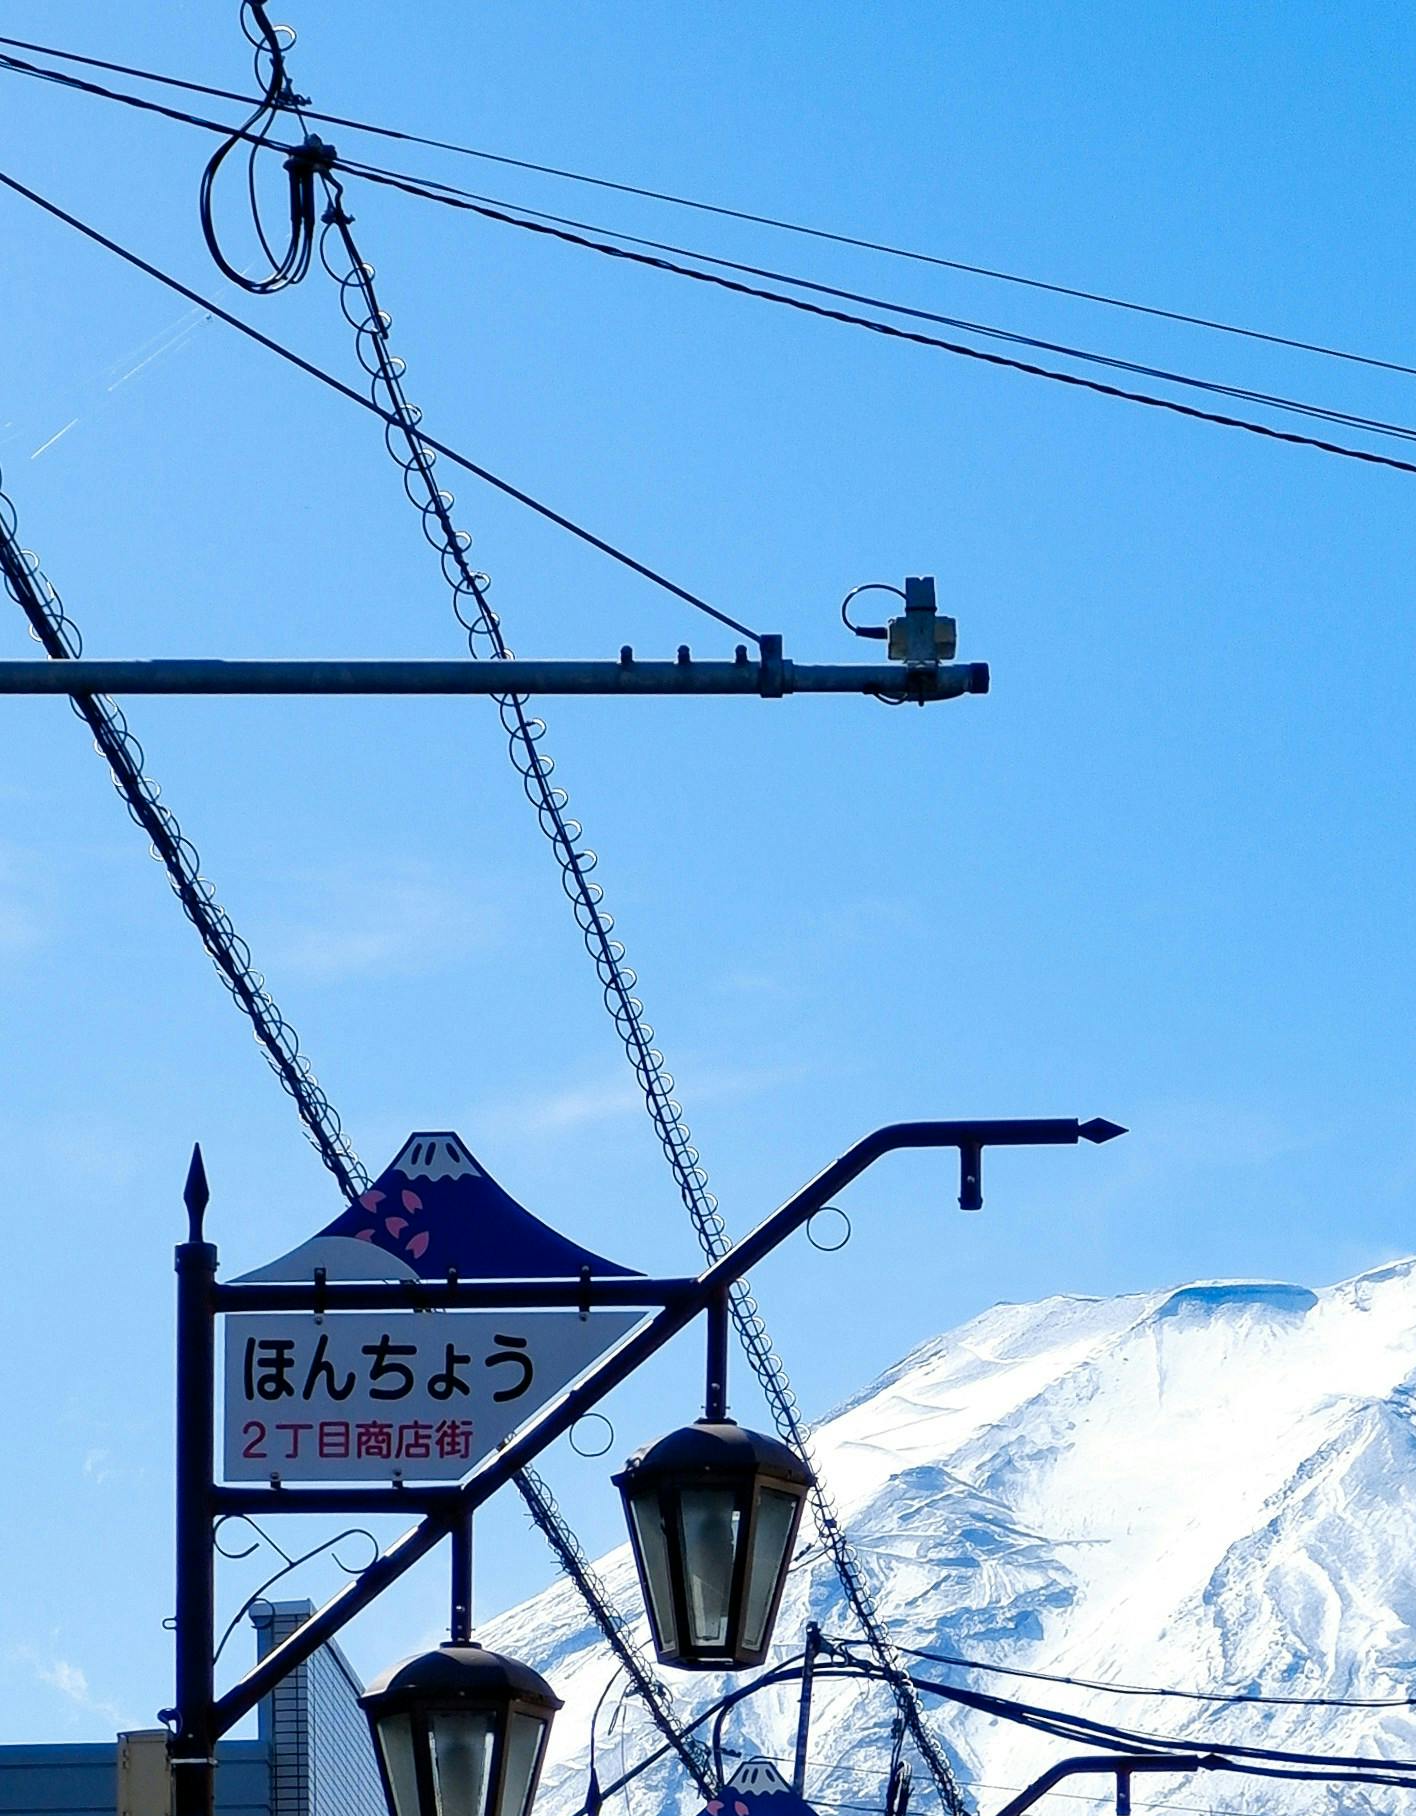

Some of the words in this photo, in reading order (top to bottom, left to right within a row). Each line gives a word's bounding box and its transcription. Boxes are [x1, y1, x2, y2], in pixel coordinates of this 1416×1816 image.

[243, 1334, 534, 1403] ほんちょう
[242, 1420, 474, 1461] 2丁目商店街
